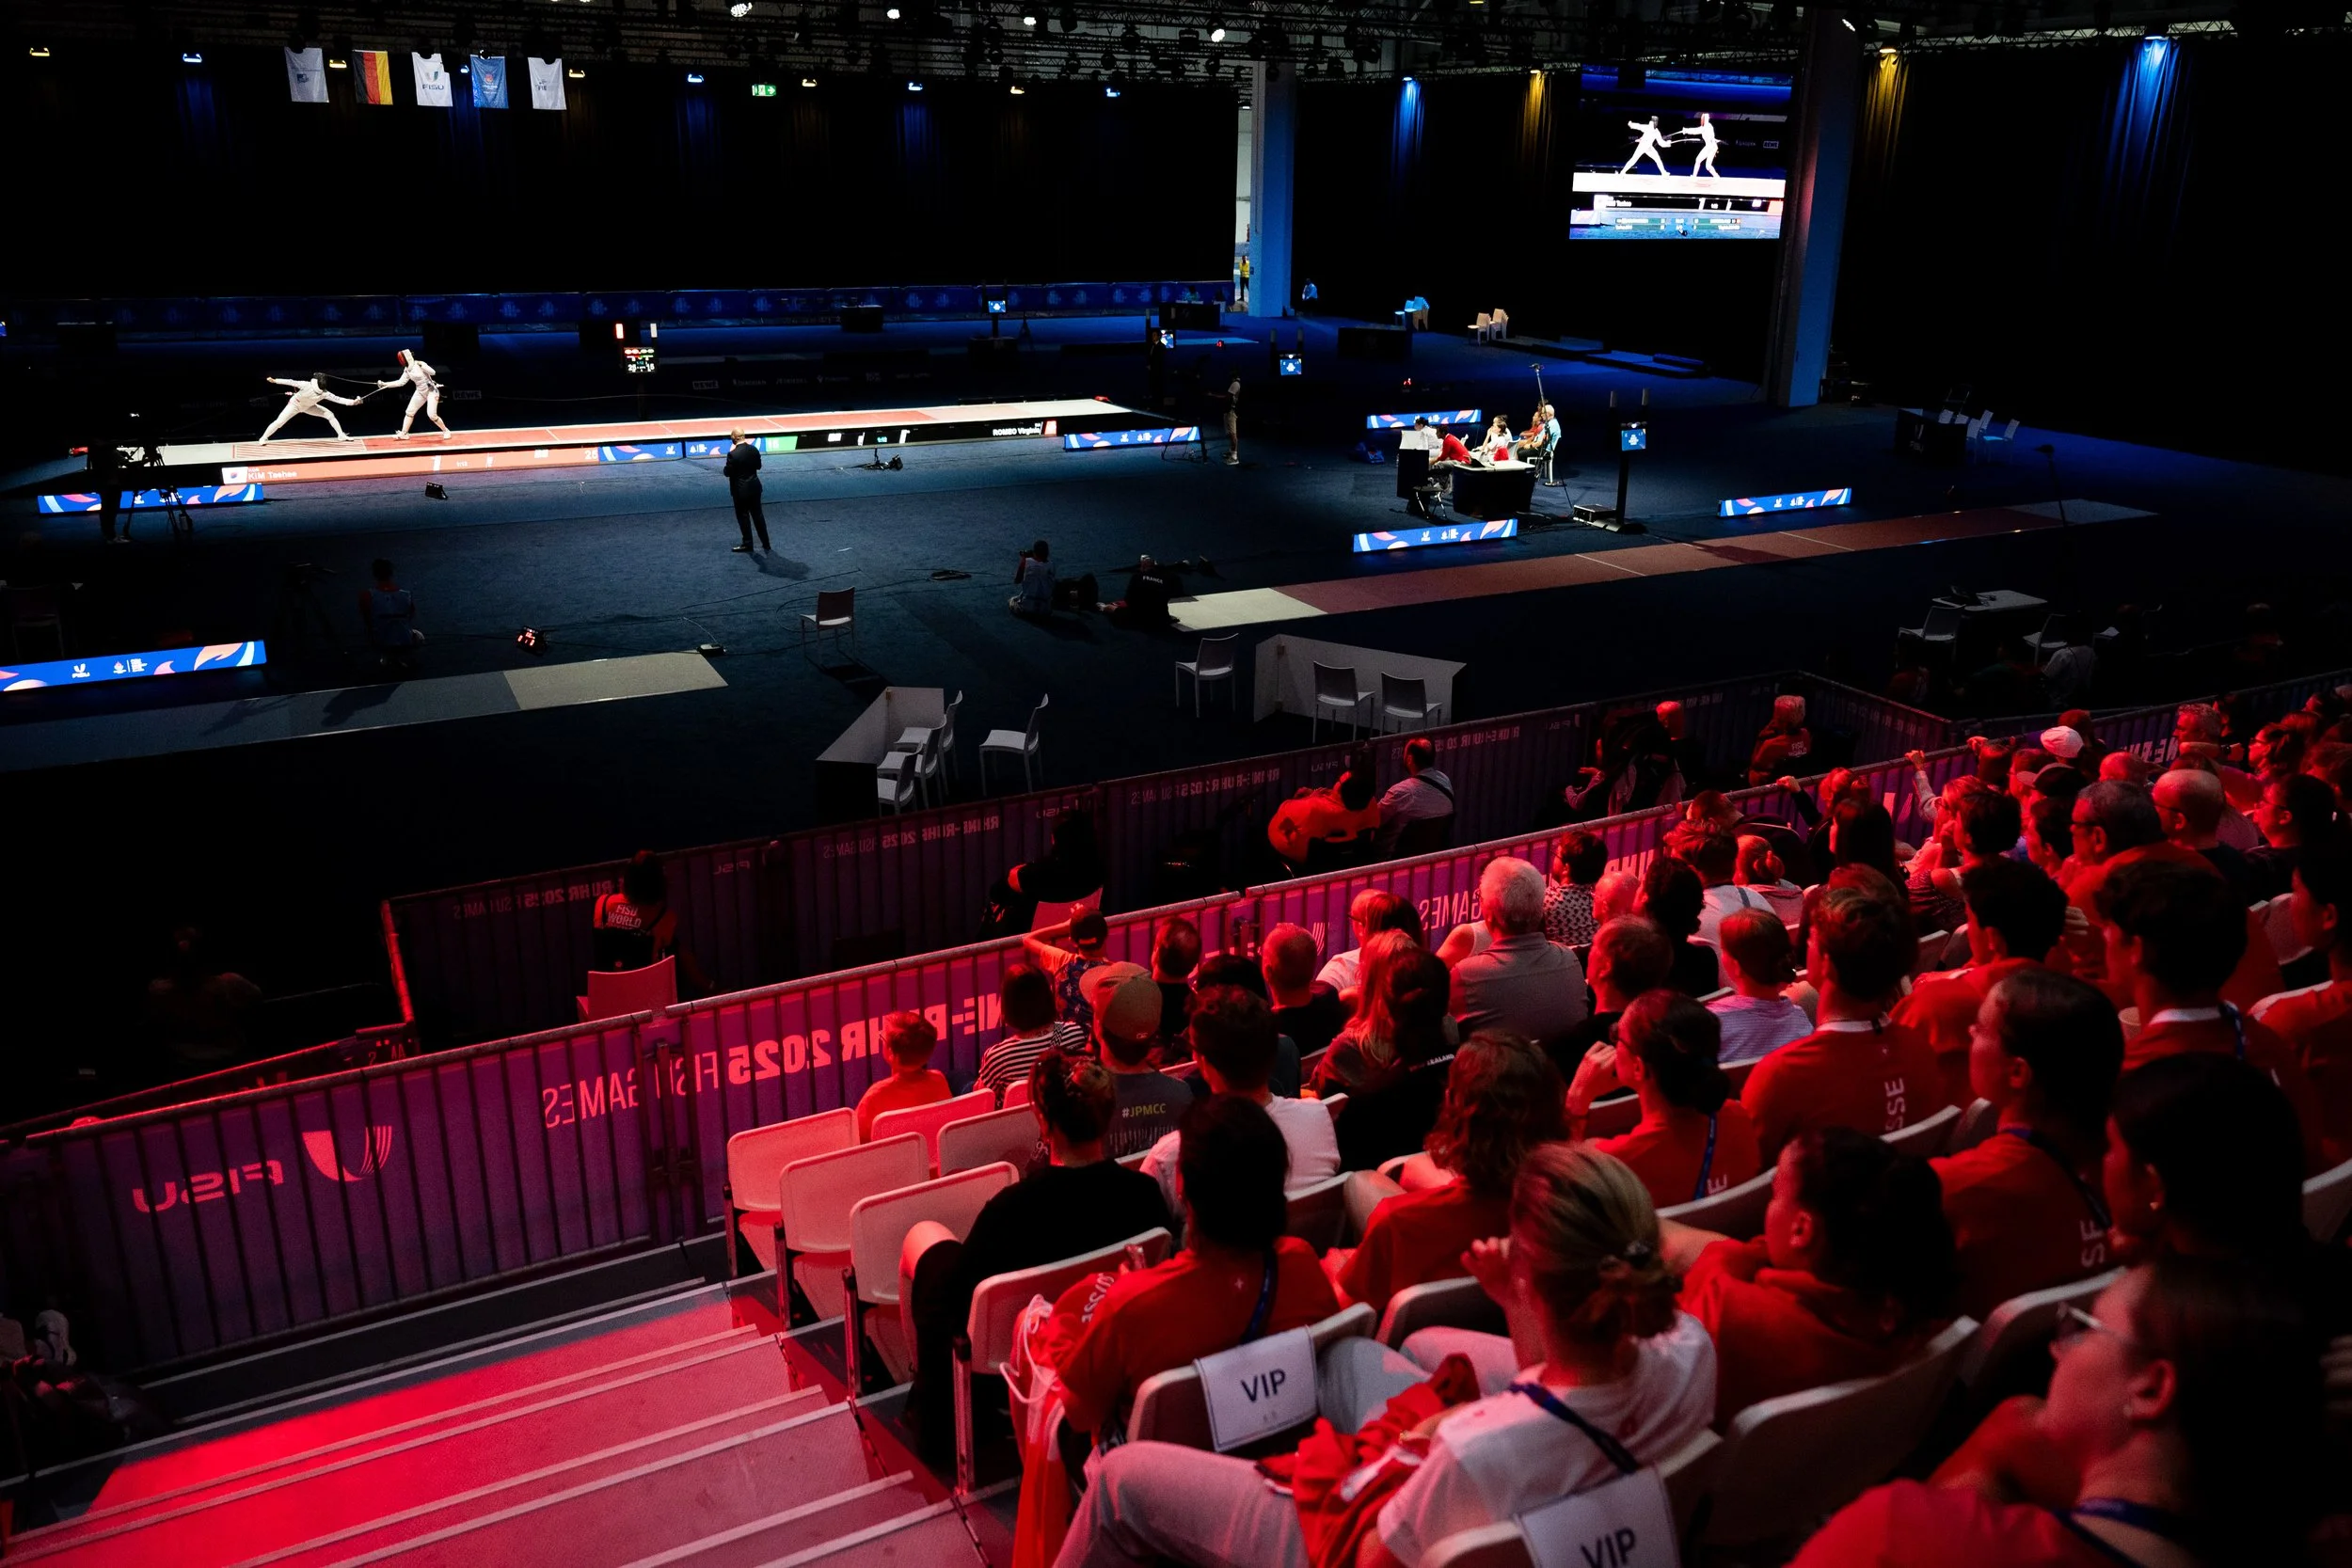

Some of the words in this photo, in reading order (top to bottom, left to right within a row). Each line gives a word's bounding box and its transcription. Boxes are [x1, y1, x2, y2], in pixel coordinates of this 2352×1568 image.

[248, 471, 265, 480] KIM
[616, 903, 639, 917] FISU
[607, 911, 643, 929] WORLD
[1121, 1102, 1167, 1118] #JPMCC
[1240, 1368, 1286, 1402] VIP
[1580, 1528, 1636, 1568] VIP
